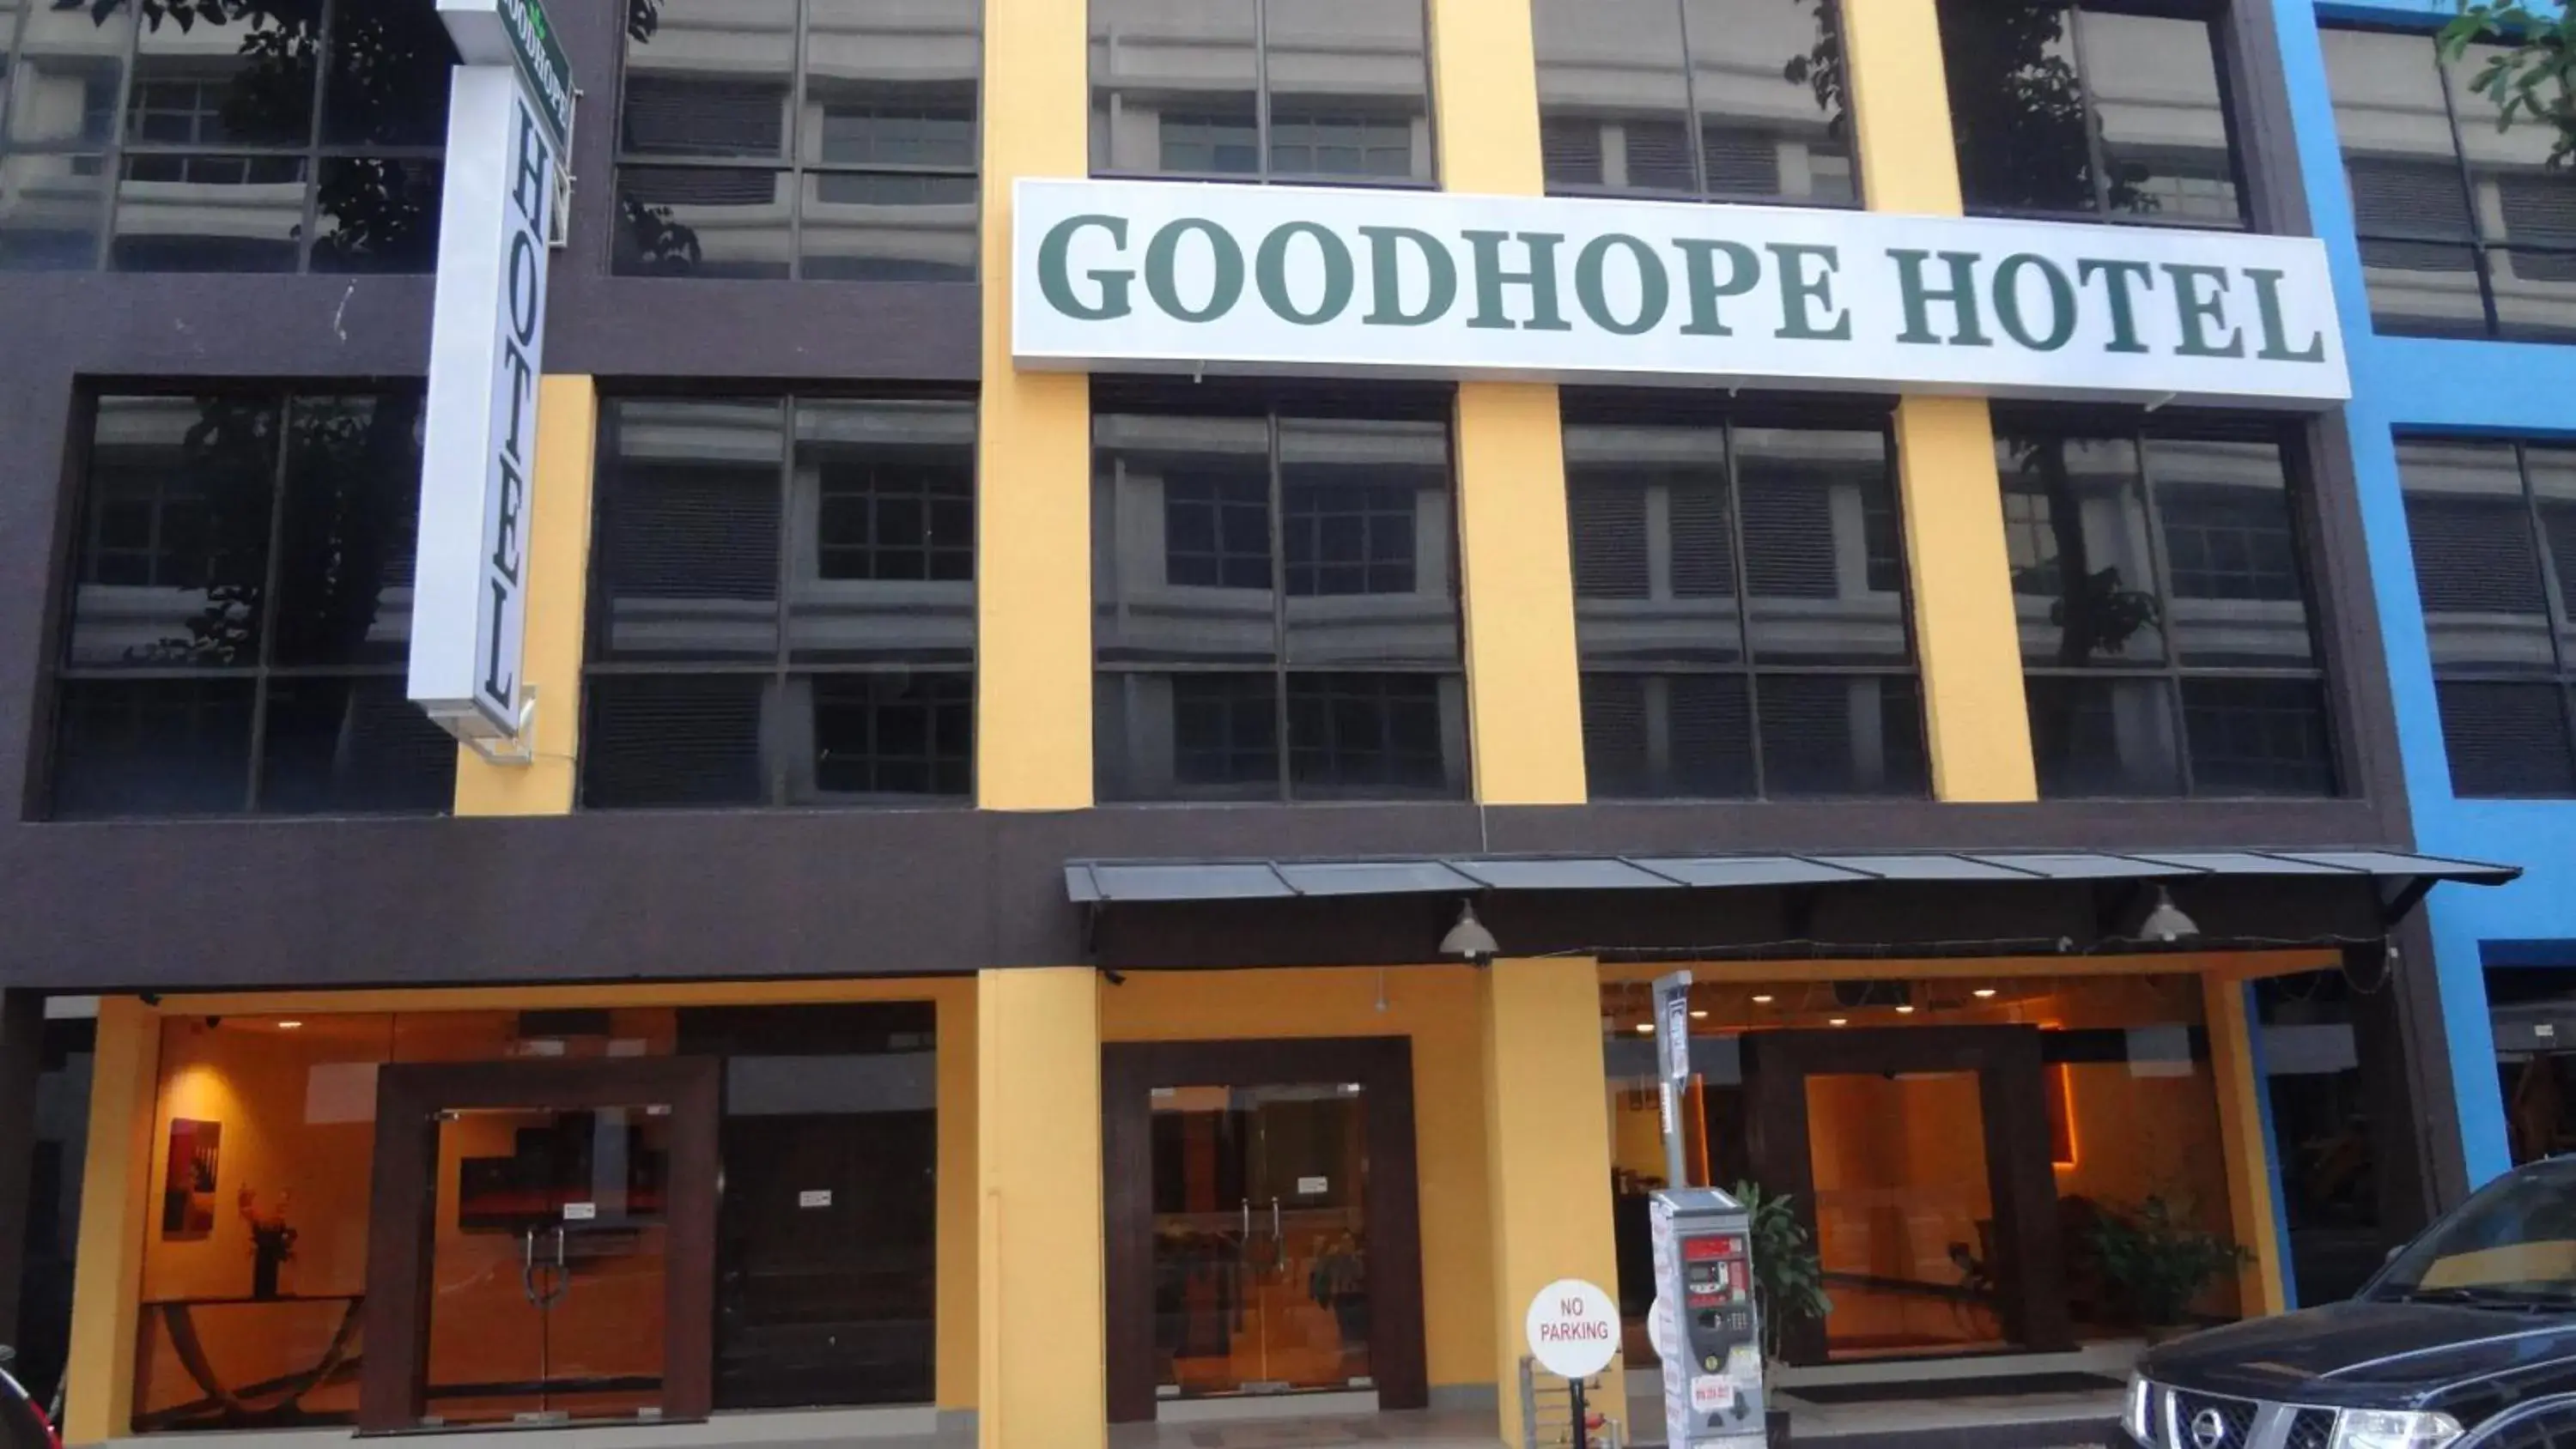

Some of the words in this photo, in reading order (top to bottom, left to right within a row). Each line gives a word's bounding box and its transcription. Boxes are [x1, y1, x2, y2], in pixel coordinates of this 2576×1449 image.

[503, 0, 568, 130] OODHOPE
[1037, 214, 1851, 341] GOODHOPE
[1886, 247, 2326, 363] HOTEL
[483, 95, 549, 712] HOTEL
[1540, 1321, 1608, 1341] PARKING
[1560, 1297, 1584, 1316] NO
